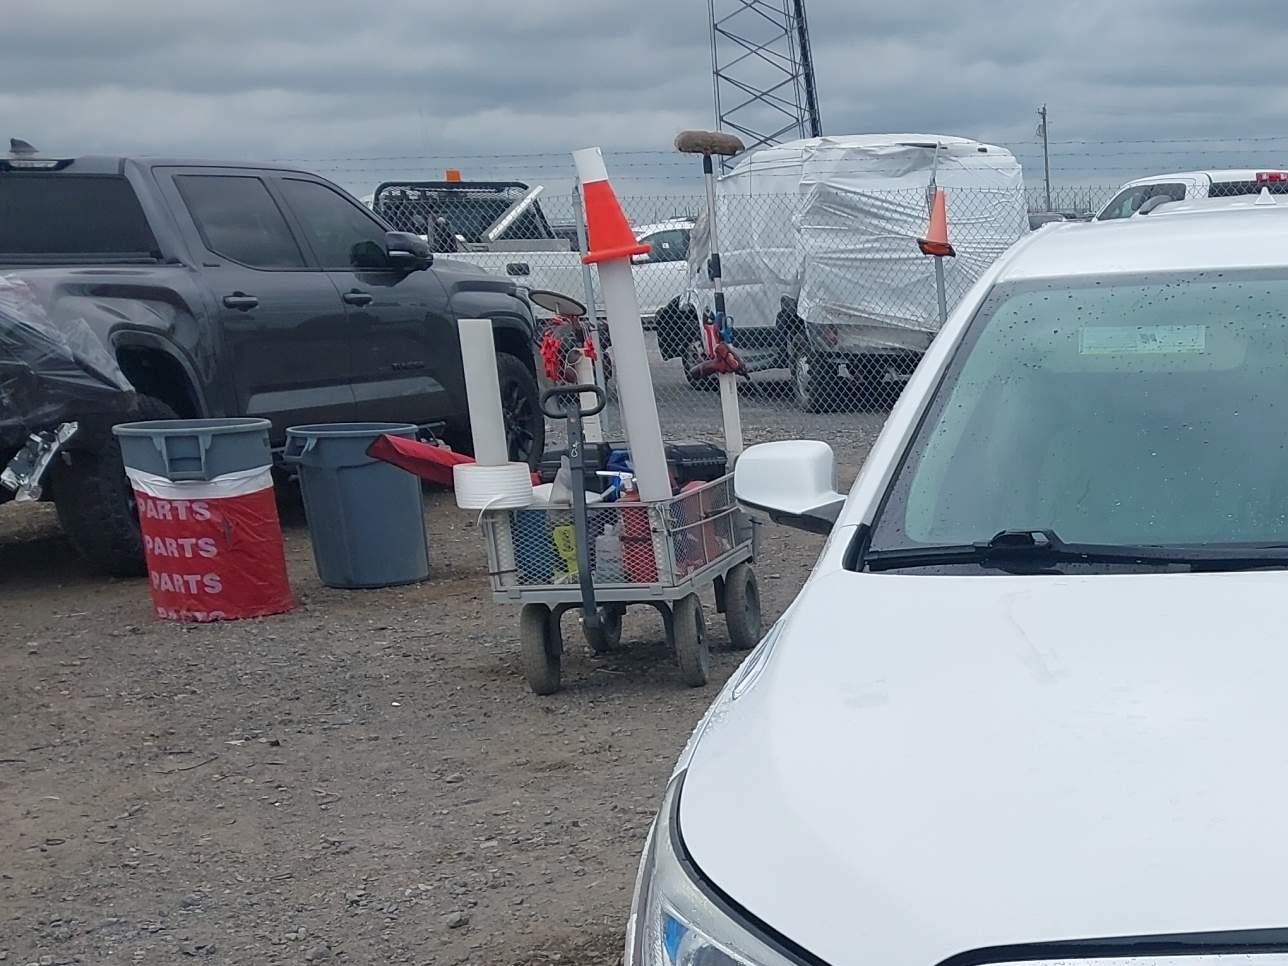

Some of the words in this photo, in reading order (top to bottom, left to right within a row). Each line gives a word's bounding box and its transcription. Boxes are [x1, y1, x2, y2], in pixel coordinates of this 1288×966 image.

[138, 500, 211, 521] PARTS
[145, 535, 218, 559] PARTS
[151, 571, 222, 594] PARTS
